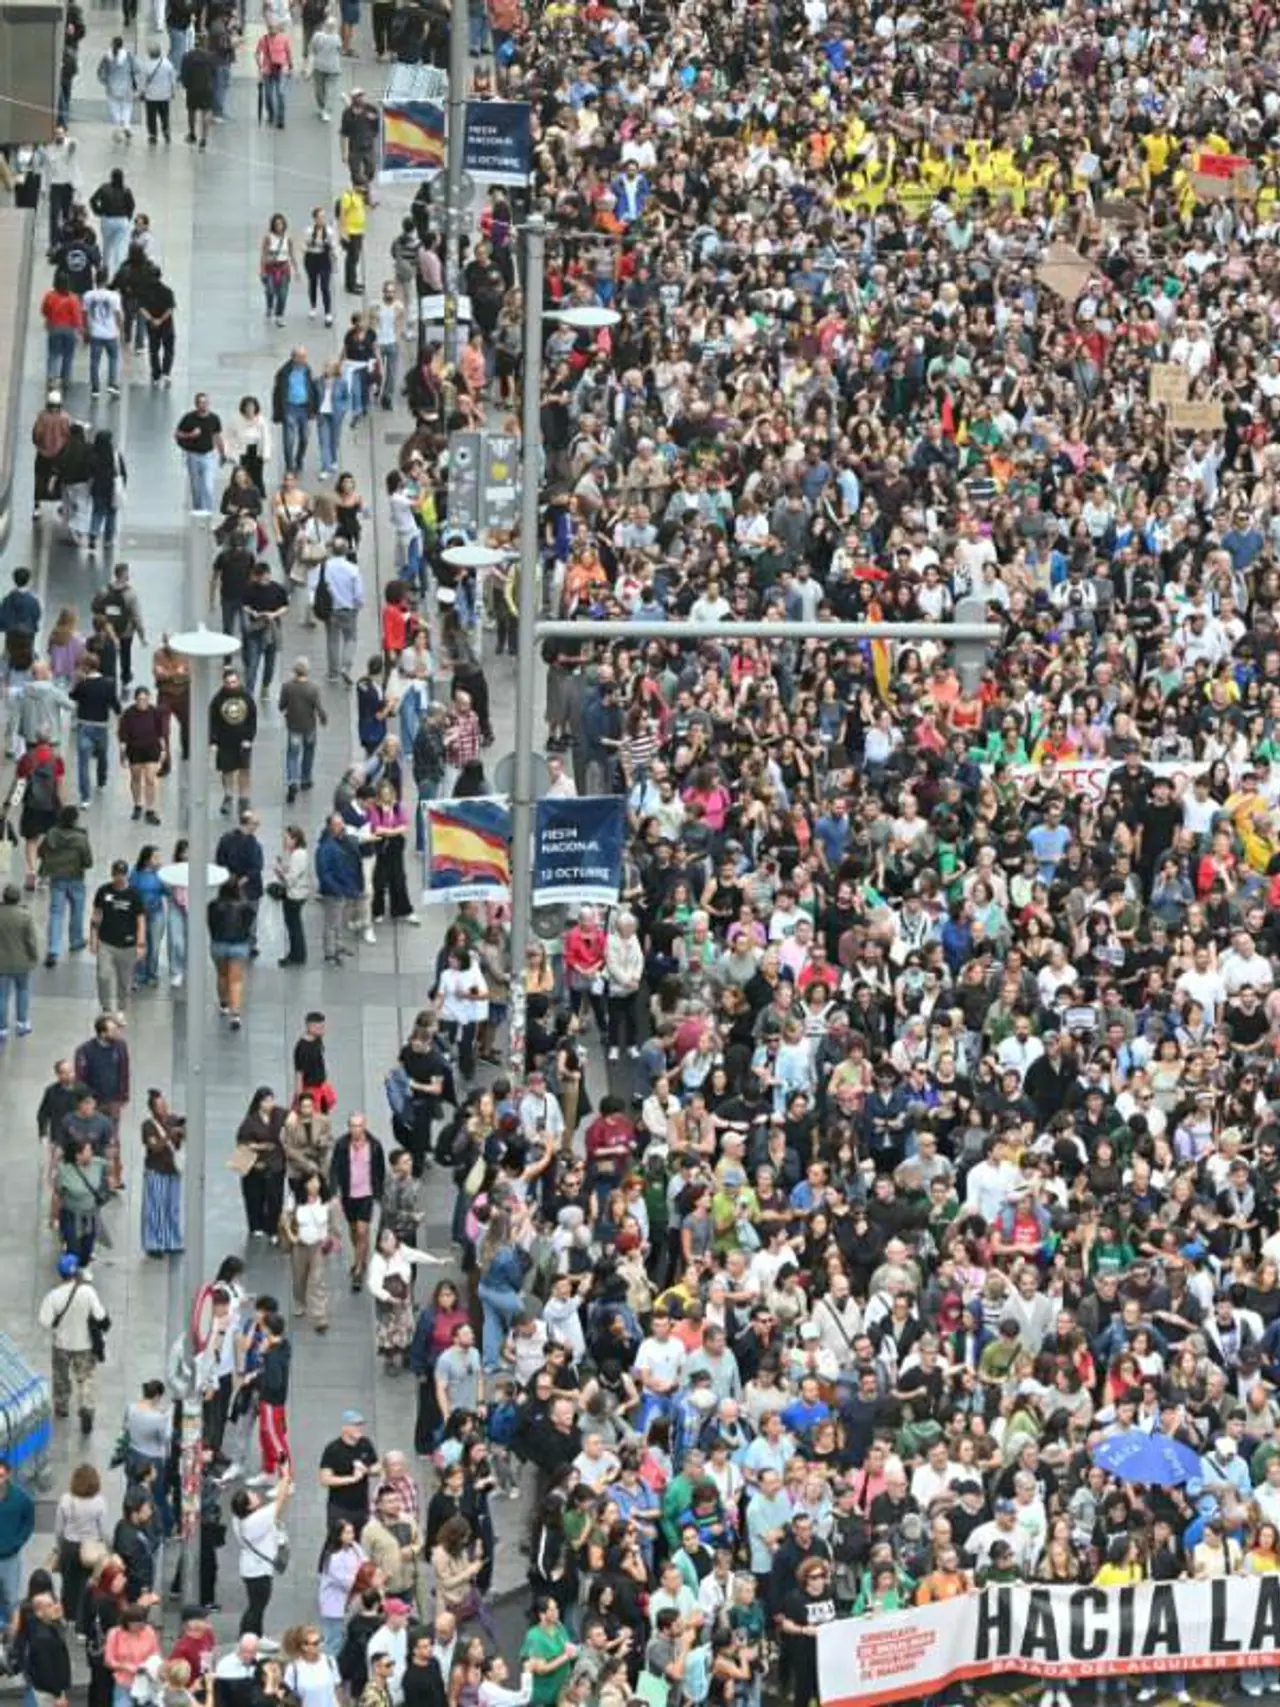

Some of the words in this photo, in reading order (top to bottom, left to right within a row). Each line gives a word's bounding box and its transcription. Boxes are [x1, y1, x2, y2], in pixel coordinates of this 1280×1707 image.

[541, 840, 602, 854] NACIONAL
[554, 866, 609, 881] OCTUBRE
[976, 1584, 1181, 1661] HACIA
[1080, 1660, 1121, 1674] DEL
